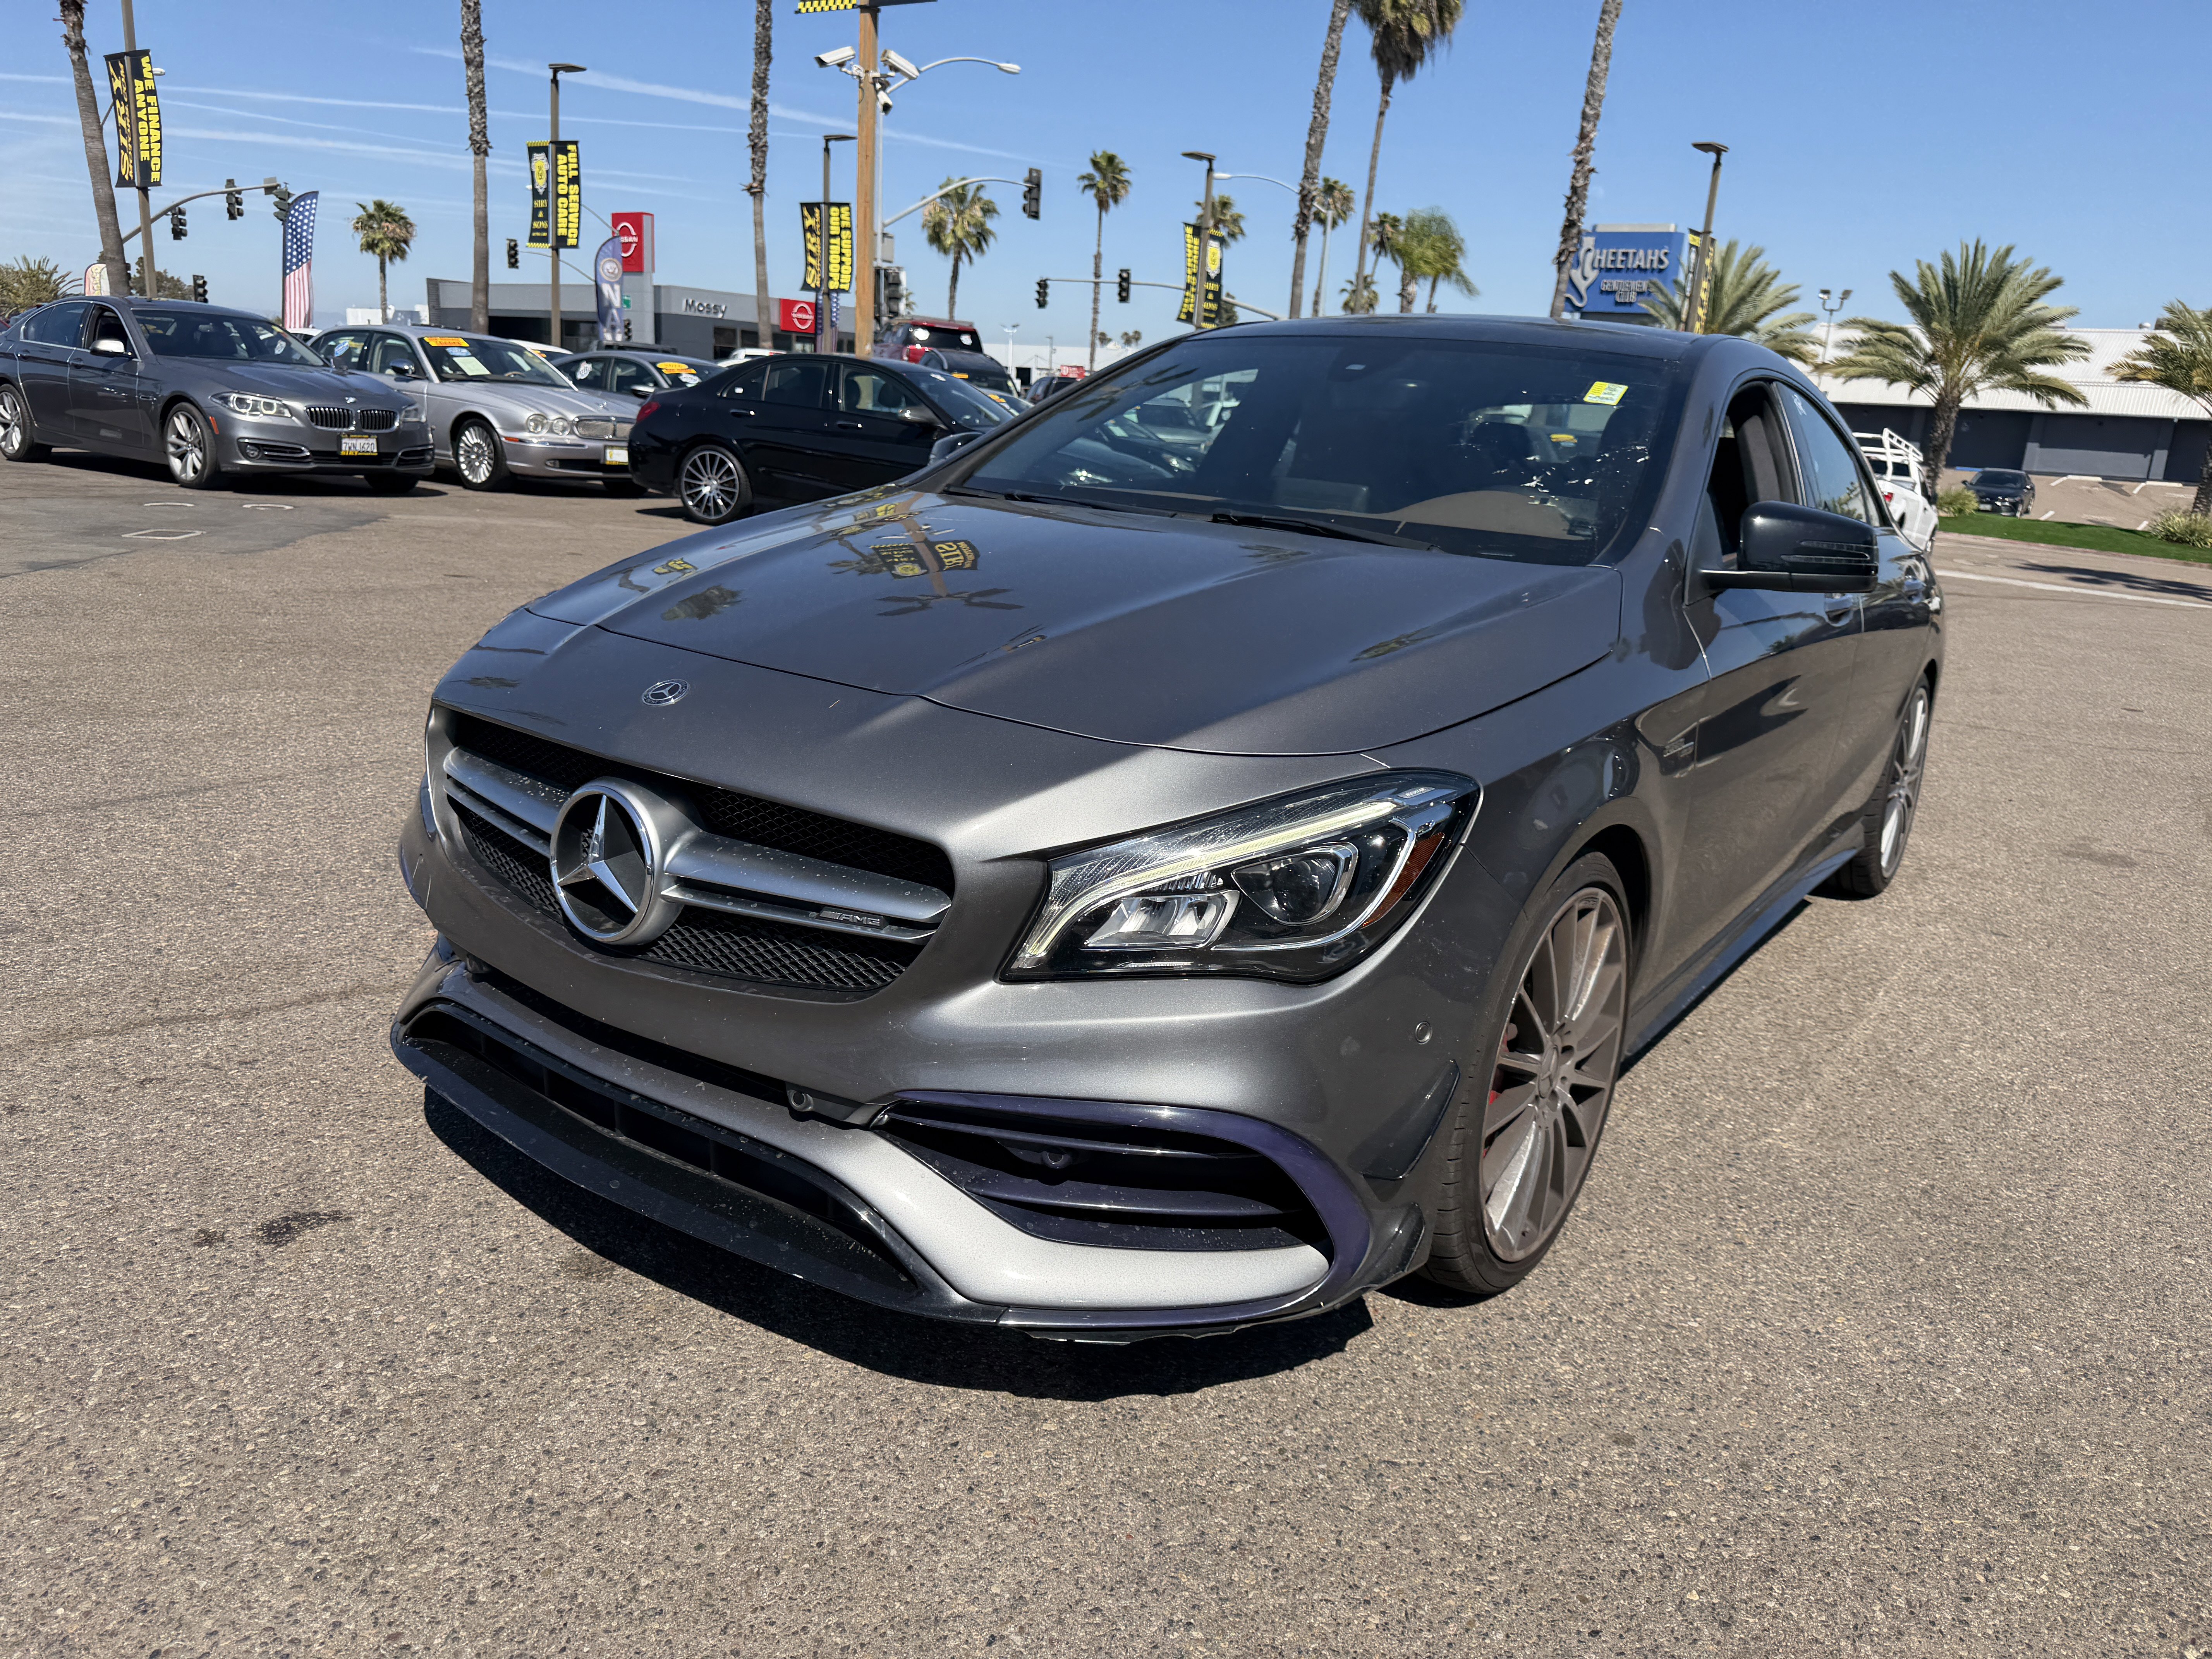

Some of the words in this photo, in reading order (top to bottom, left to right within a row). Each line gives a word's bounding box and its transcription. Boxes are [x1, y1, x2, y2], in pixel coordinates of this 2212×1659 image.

[141, 55, 155, 91] WE
[108, 61, 129, 181] SIRY
[134, 79, 150, 161] ANYONE
[146, 96, 161, 182] FINANCE
[557, 154, 568, 195] AUTO
[567, 145, 578, 179] FULL
[557, 198, 568, 236] CARE
[567, 184, 579, 246] SERVICE
[829, 206, 840, 235] OUR
[840, 206, 851, 228] WE
[802, 206, 817, 289] SIRY
[828, 236, 840, 290] TROOPS
[839, 229, 852, 290] SUPPORT
[682, 298, 727, 318] Mossy
[838, 914, 880, 926] AMG
